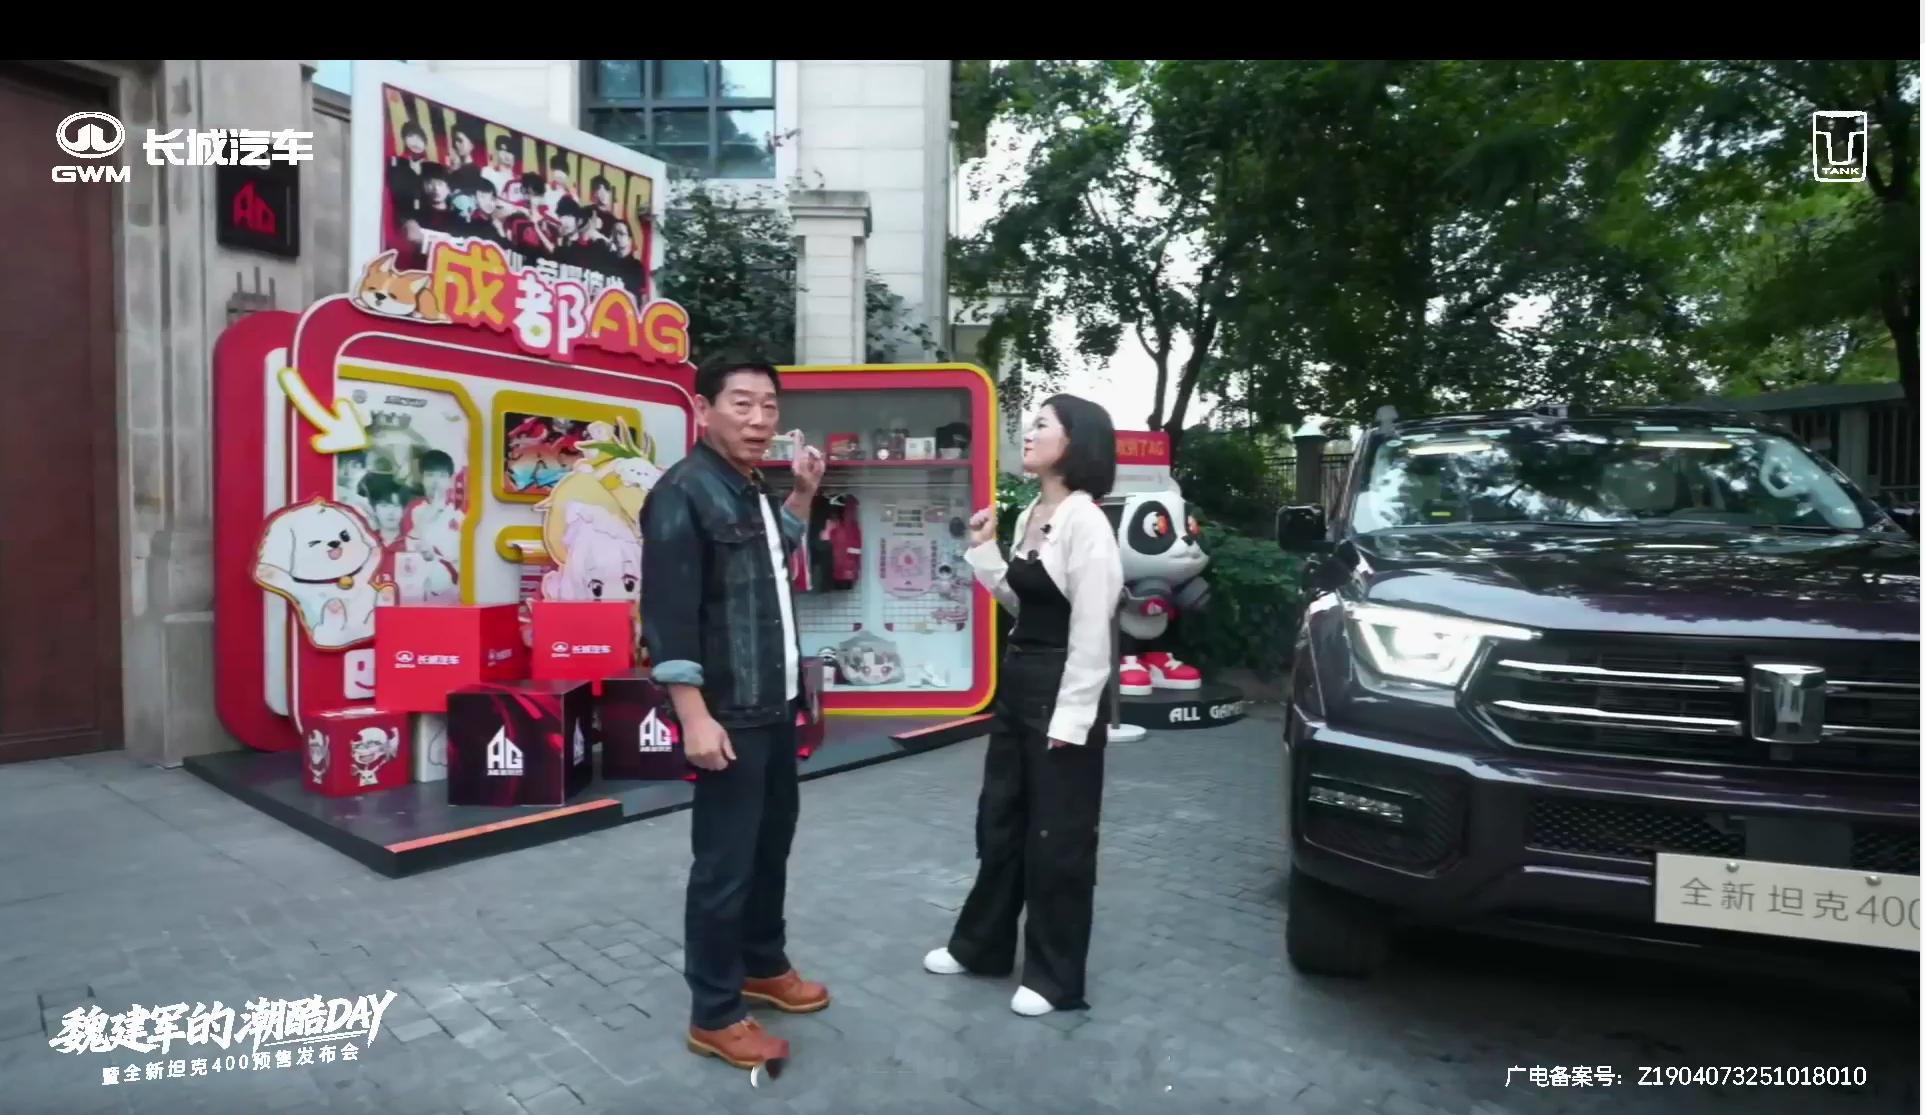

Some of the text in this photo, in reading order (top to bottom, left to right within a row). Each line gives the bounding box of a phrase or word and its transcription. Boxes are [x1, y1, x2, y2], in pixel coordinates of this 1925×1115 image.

[433, 241, 686, 357] 成都AG
[638, 707, 673, 746] AG
[1169, 707, 1201, 723] ALL
[486, 725, 525, 768] AG
